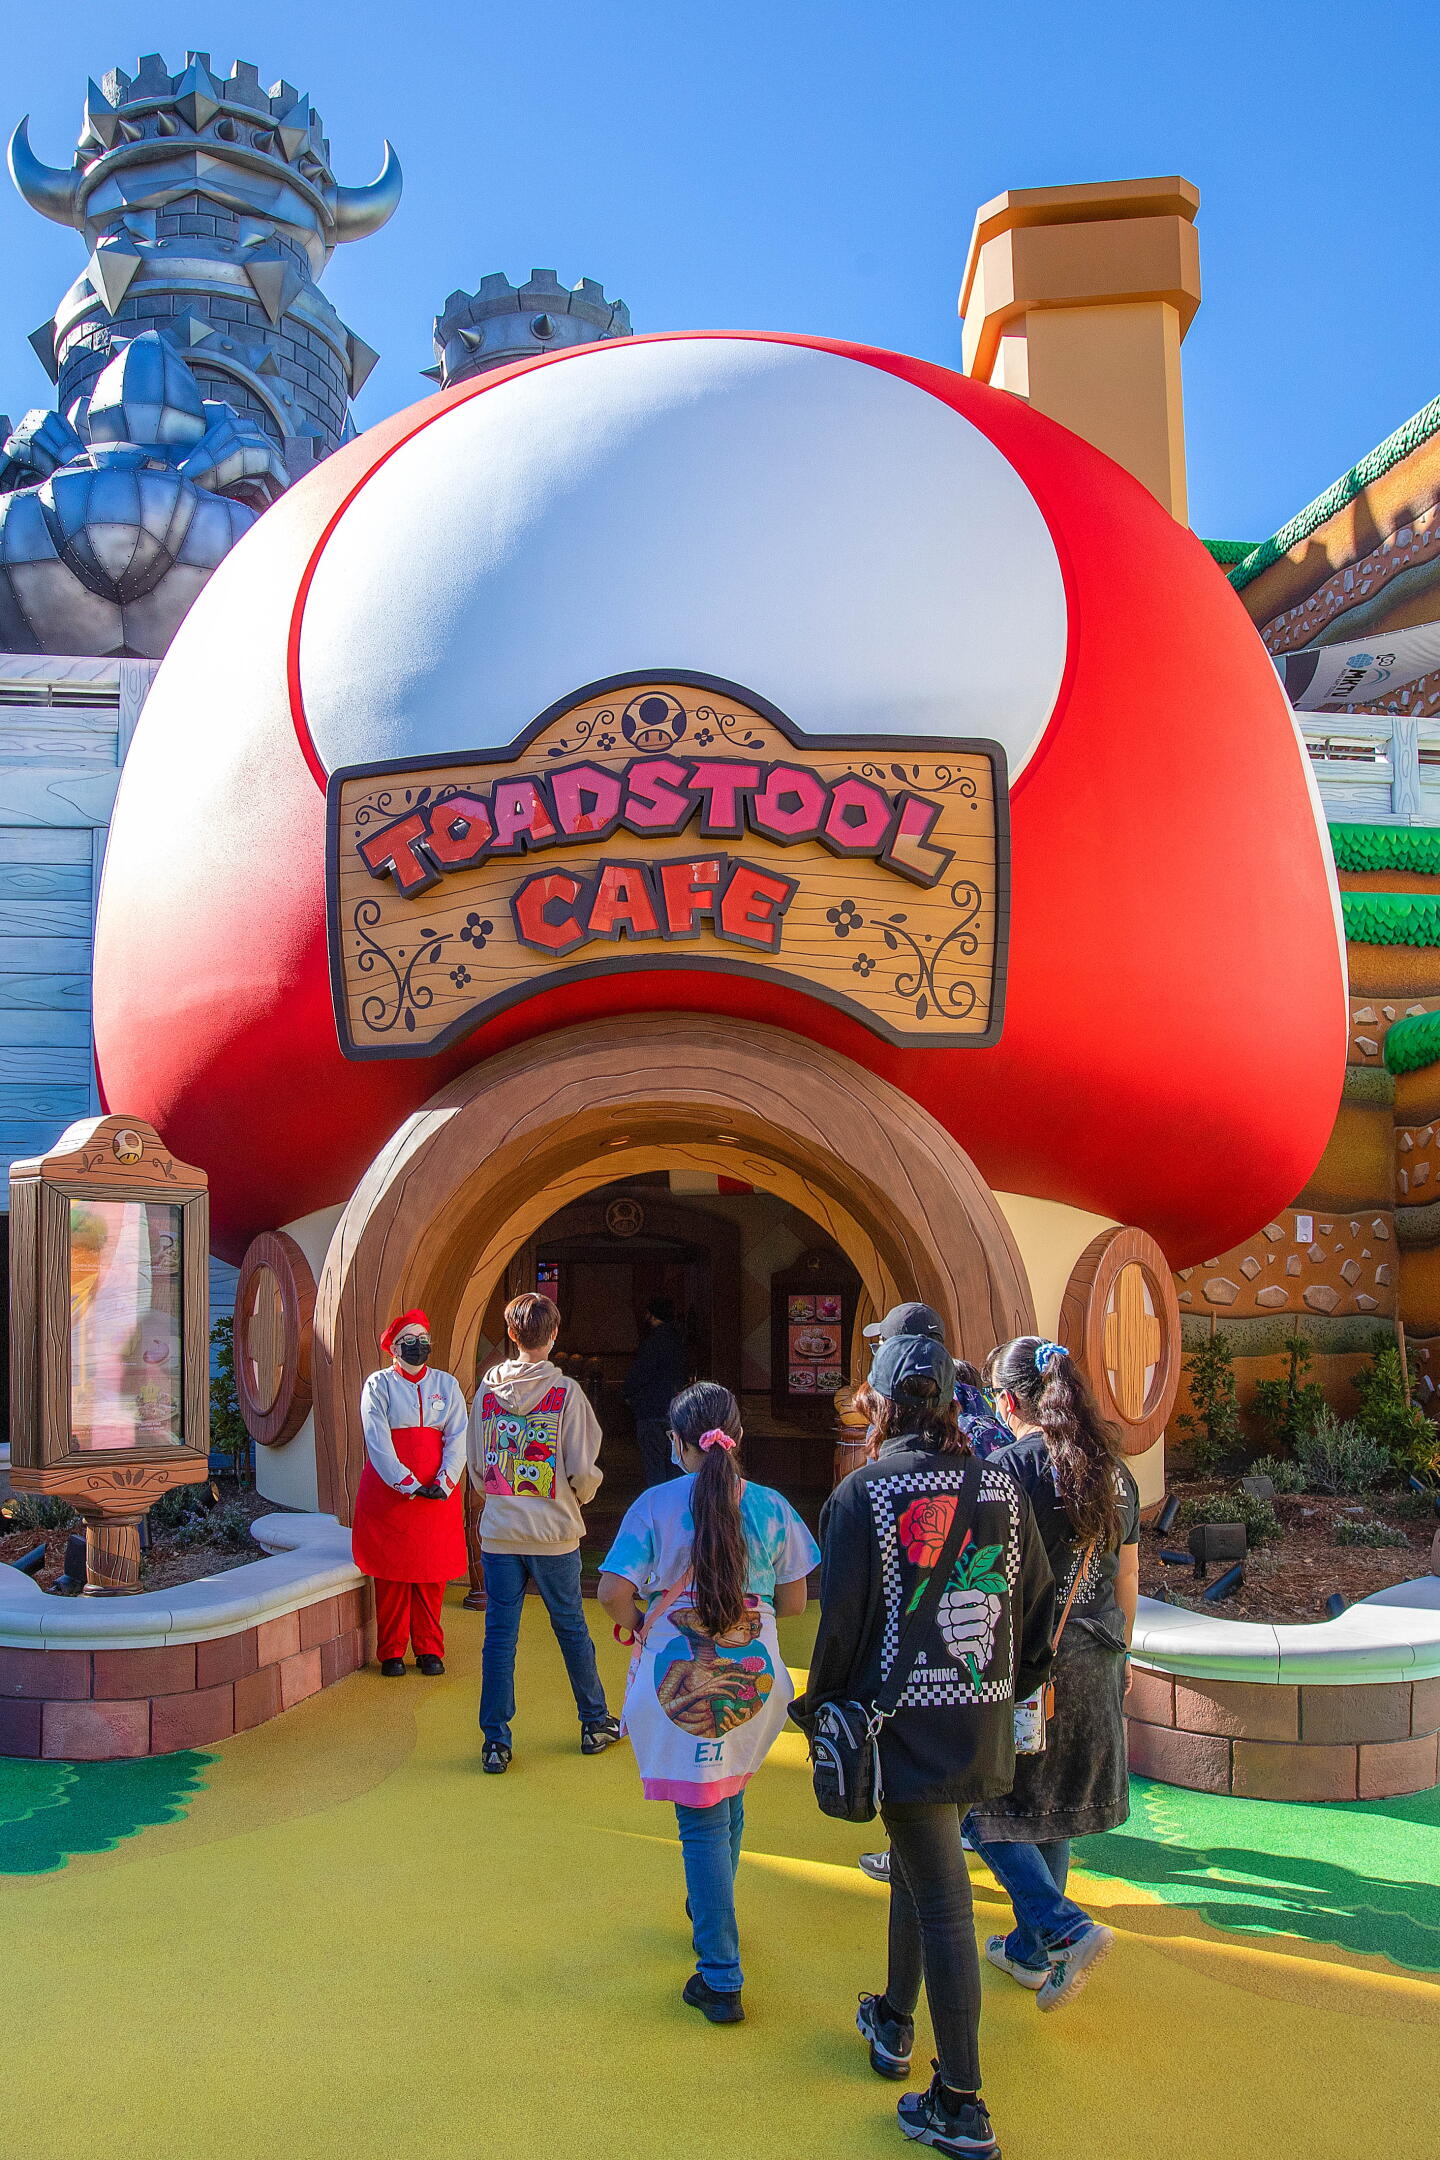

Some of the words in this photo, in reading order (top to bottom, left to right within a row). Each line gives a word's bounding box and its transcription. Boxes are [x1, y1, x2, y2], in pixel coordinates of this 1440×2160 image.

[1330, 669, 1367, 697] MKTV
[356, 756, 956, 897] TOADSTOOL
[511, 854, 800, 955] CAFE
[482, 1386, 566, 1421] SPOOB
[977, 1489, 1006, 1502] ANKS
[694, 1741, 725, 1763] E.T.
